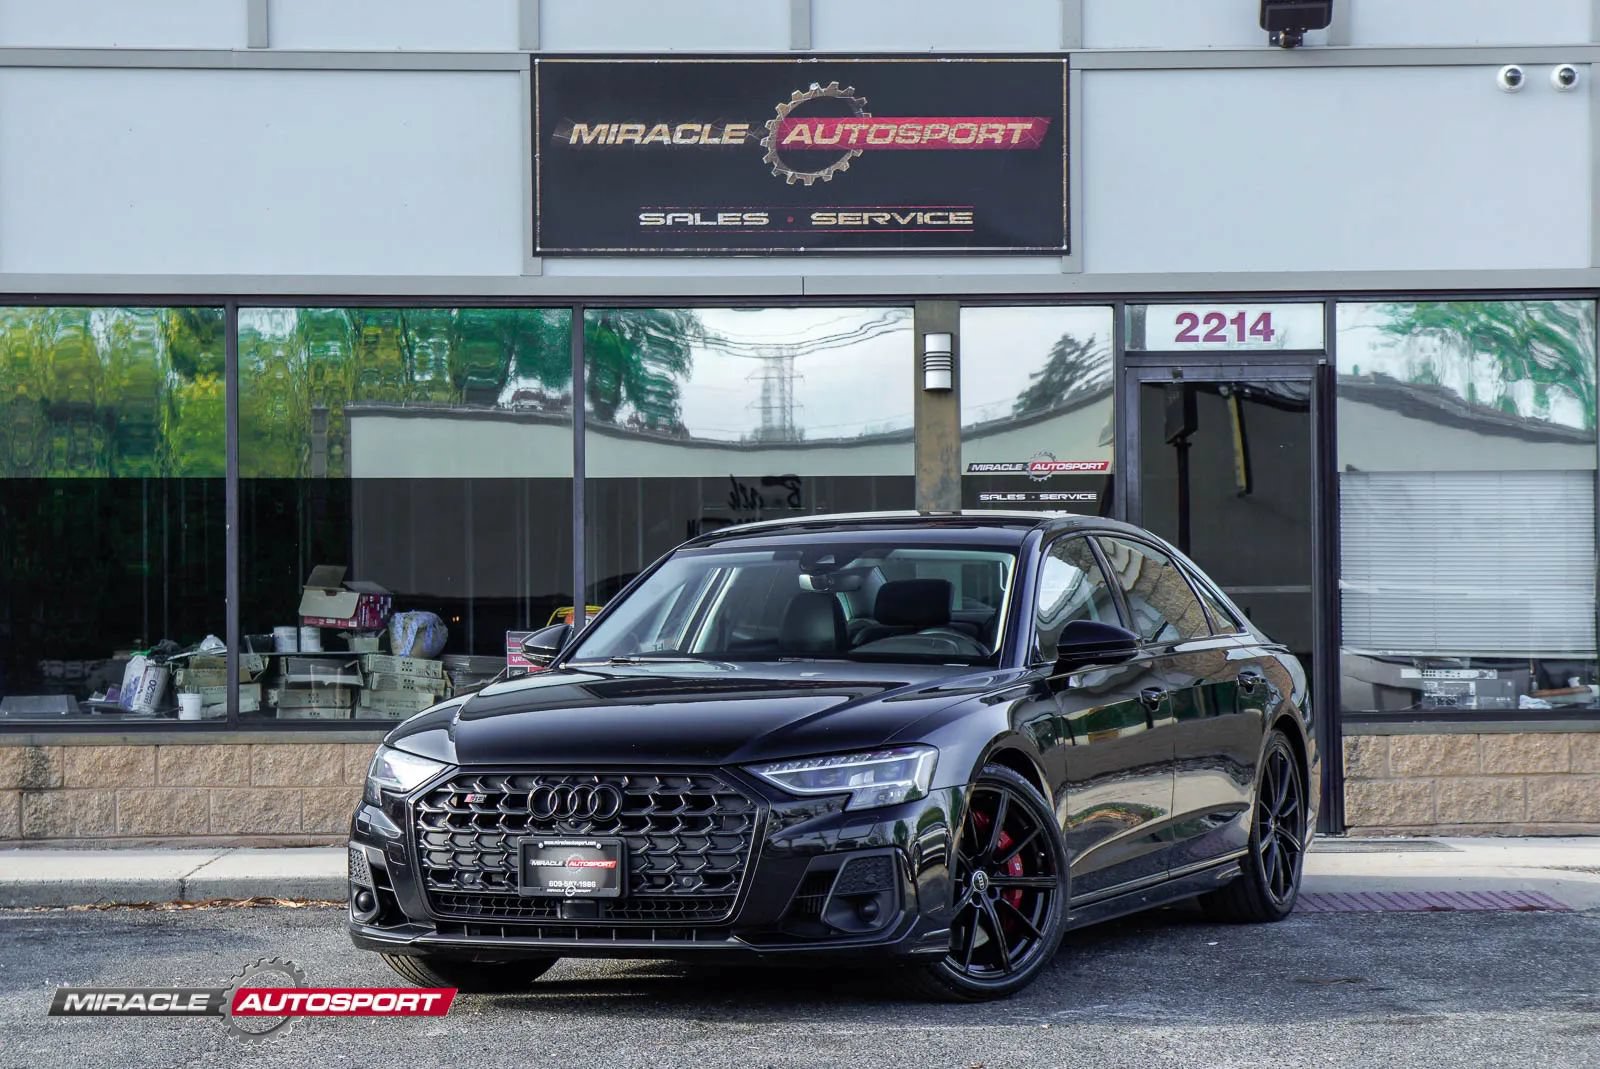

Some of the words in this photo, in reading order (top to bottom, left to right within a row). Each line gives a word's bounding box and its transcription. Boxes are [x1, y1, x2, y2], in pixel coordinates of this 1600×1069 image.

[568, 123, 750, 146] MIRACLE
[781, 121, 1033, 146] AUTOSPORT
[638, 212, 771, 227] SALES
[810, 211, 975, 227] SERVICE
[1174, 311, 1275, 343] 2214
[971, 463, 1023, 472] MIRACLE
[1032, 462, 1105, 472] AUTOSPORT
[979, 493, 1026, 501] SALES
[1039, 493, 1097, 501] SERVICE
[147, 679, 158, 693] 20
[568, 860, 614, 868] AUTOSPORT
